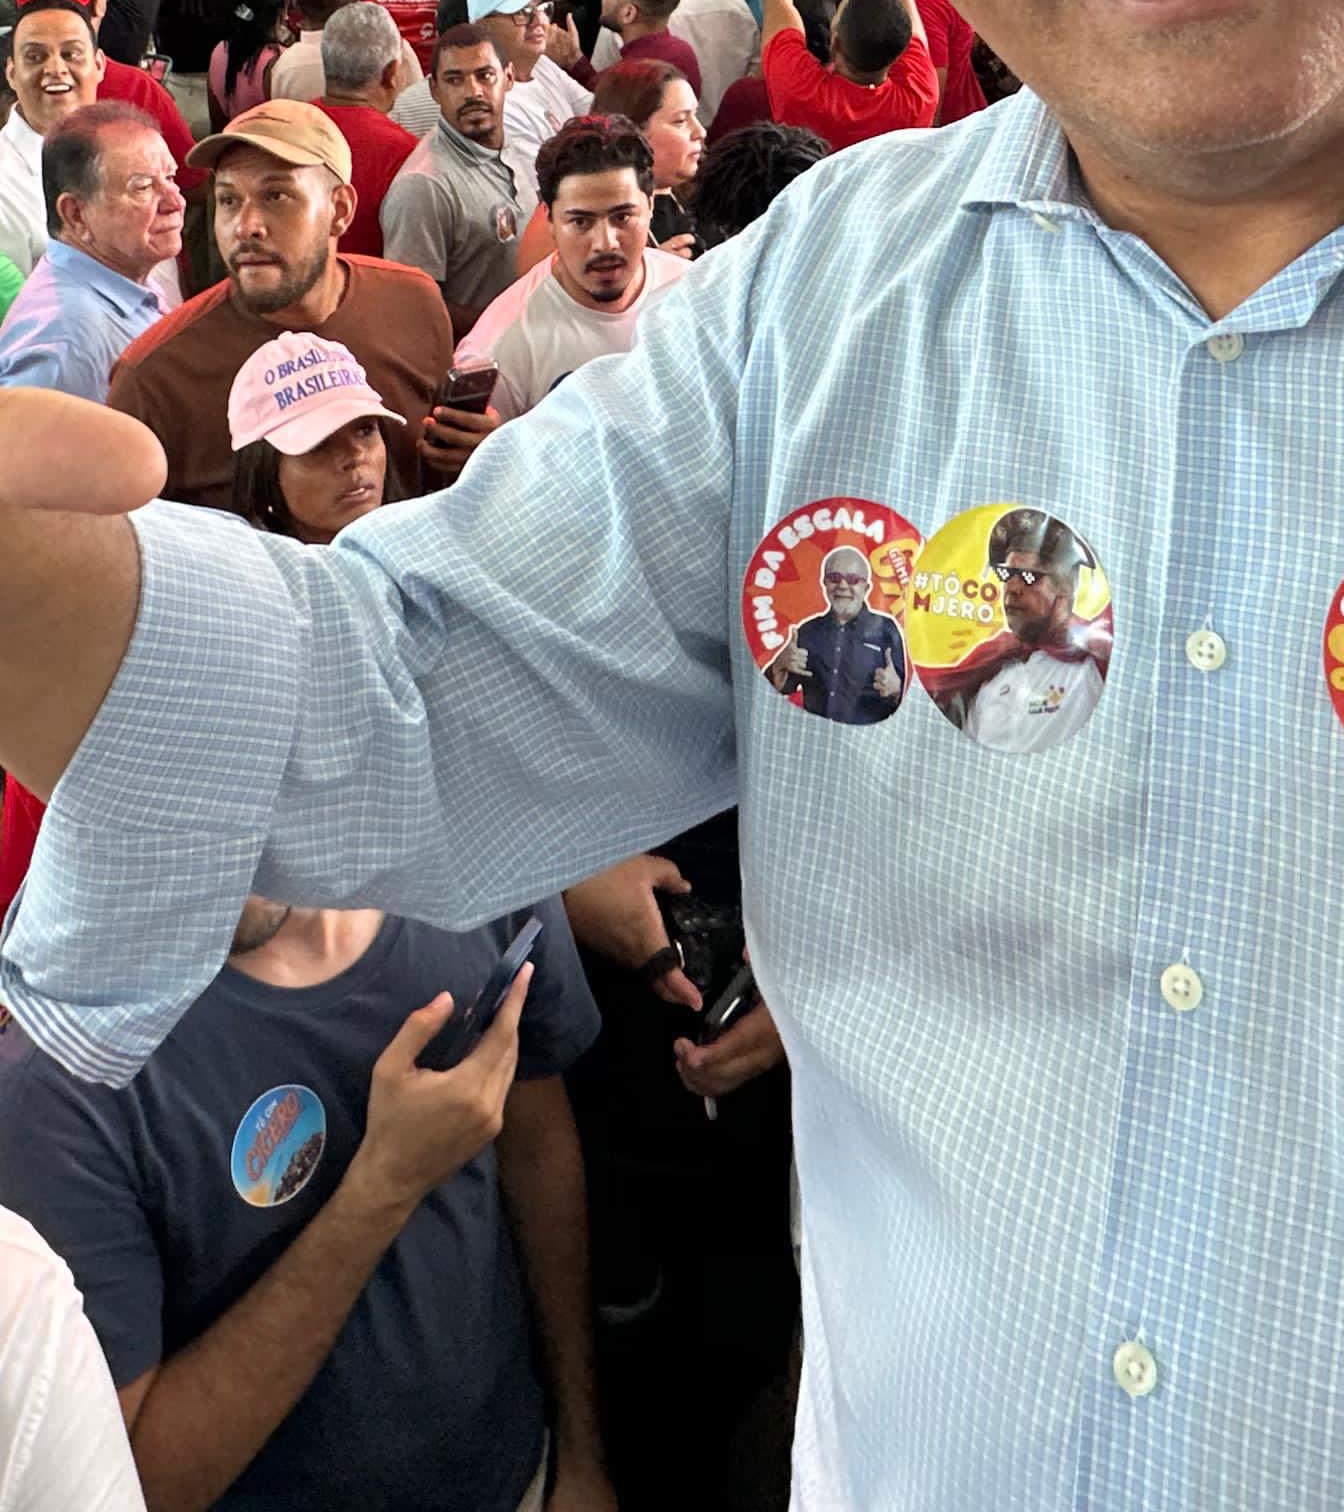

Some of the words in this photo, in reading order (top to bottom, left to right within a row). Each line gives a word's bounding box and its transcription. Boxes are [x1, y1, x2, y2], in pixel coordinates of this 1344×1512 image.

[264, 369, 276, 385] O
[276, 348, 327, 380] BRASIL
[754, 551, 785, 590] DA
[777, 507, 885, 549] ESCALA
